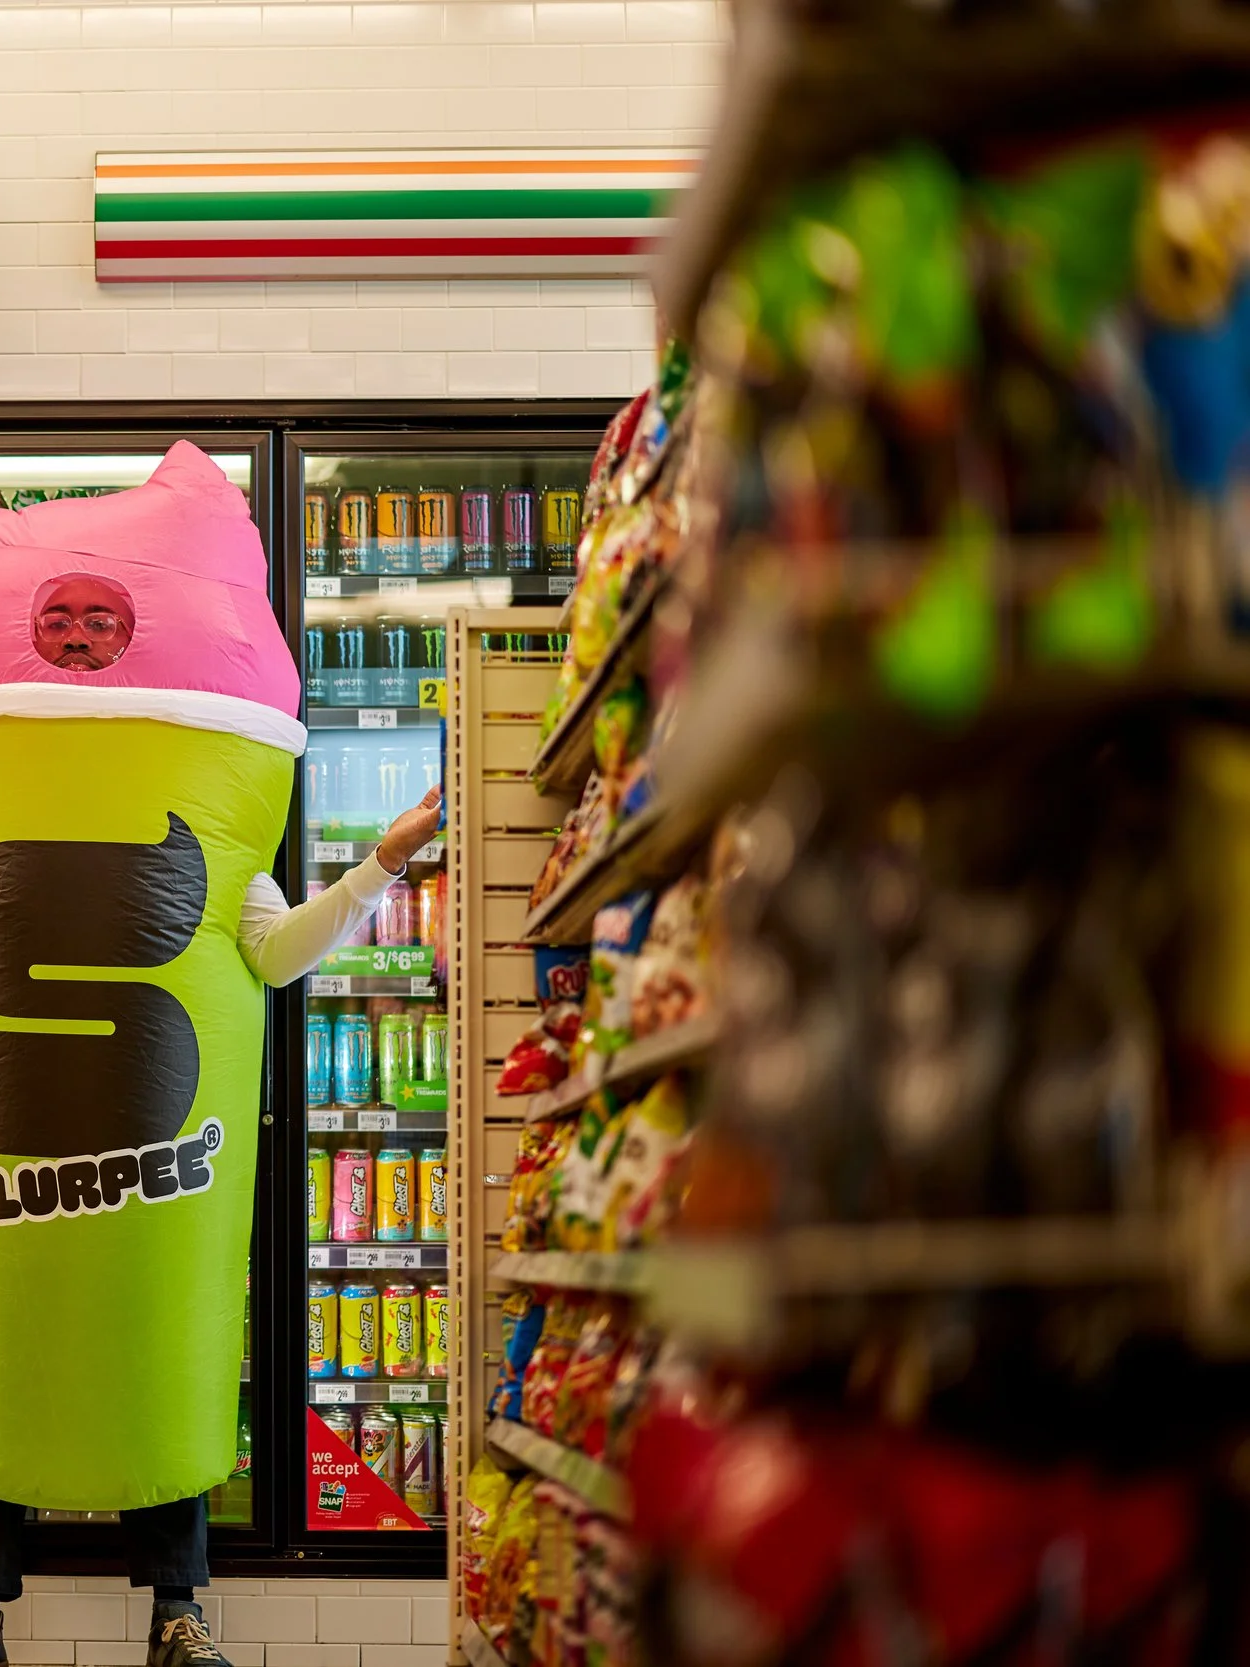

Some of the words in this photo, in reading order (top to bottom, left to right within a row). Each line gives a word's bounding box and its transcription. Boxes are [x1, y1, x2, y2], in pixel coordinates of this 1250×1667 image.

[312, 1452, 333, 1463] we
[312, 1462, 360, 1478] accept
[318, 1497, 343, 1507] SNAP
[382, 1518, 398, 1527] EBT
